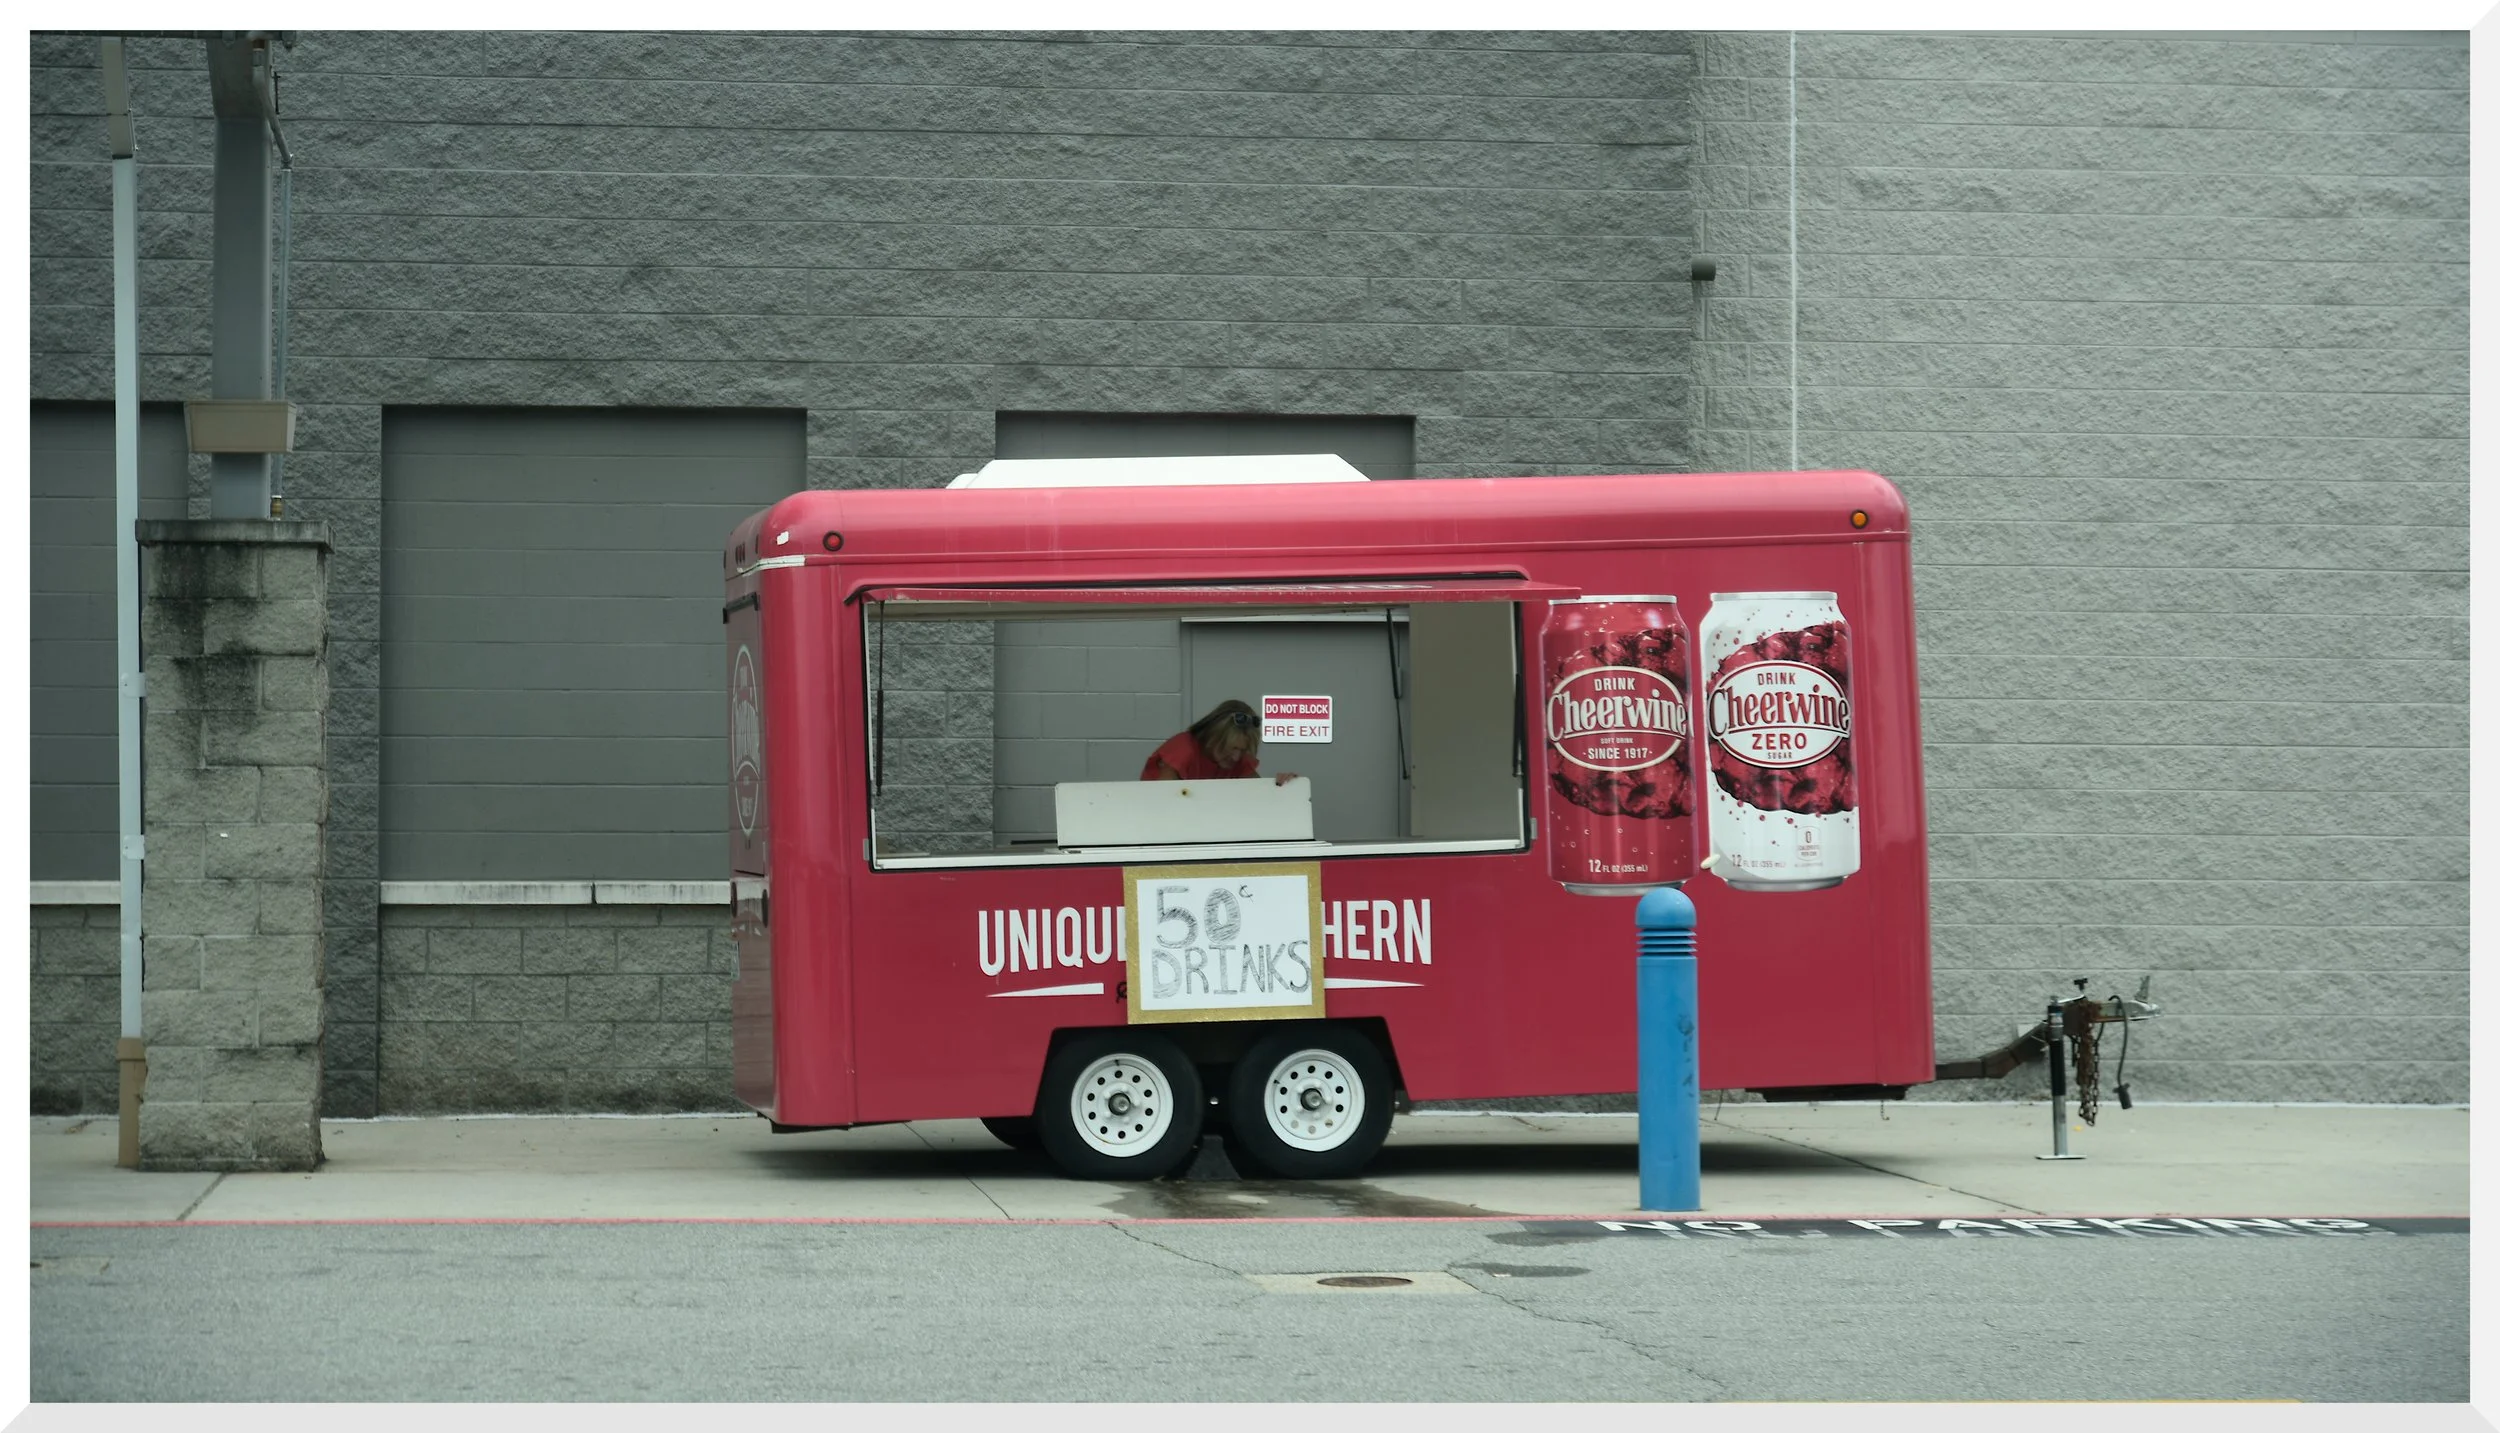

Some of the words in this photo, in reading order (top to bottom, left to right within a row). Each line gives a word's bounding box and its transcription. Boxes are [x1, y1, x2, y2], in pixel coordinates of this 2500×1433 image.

[1593, 677, 1636, 691] DRINK
[1757, 672, 1796, 686] DRINK
[1265, 703, 1278, 714] DO
[1280, 703, 1298, 714] NOT
[1299, 703, 1329, 714] BLOCK
[1546, 688, 1687, 742] Cheerwine
[1709, 684, 1850, 737] Cheerwine
[1264, 725, 1295, 737] FIRE
[1300, 725, 1330, 737] EXIT
[1751, 732, 1808, 750] ZERO
[1588, 747, 1620, 760] SINCE
[1624, 747, 1648, 759] 1917
[1805, 831, 1812, 843] 0
[1588, 859, 1601, 873] 12
[1602, 865, 1610, 873] FL
[1151, 940, 1312, 999] DRINKS
[1596, 1220, 1762, 1231] NO
[1847, 1218, 2370, 1230] PARKING
